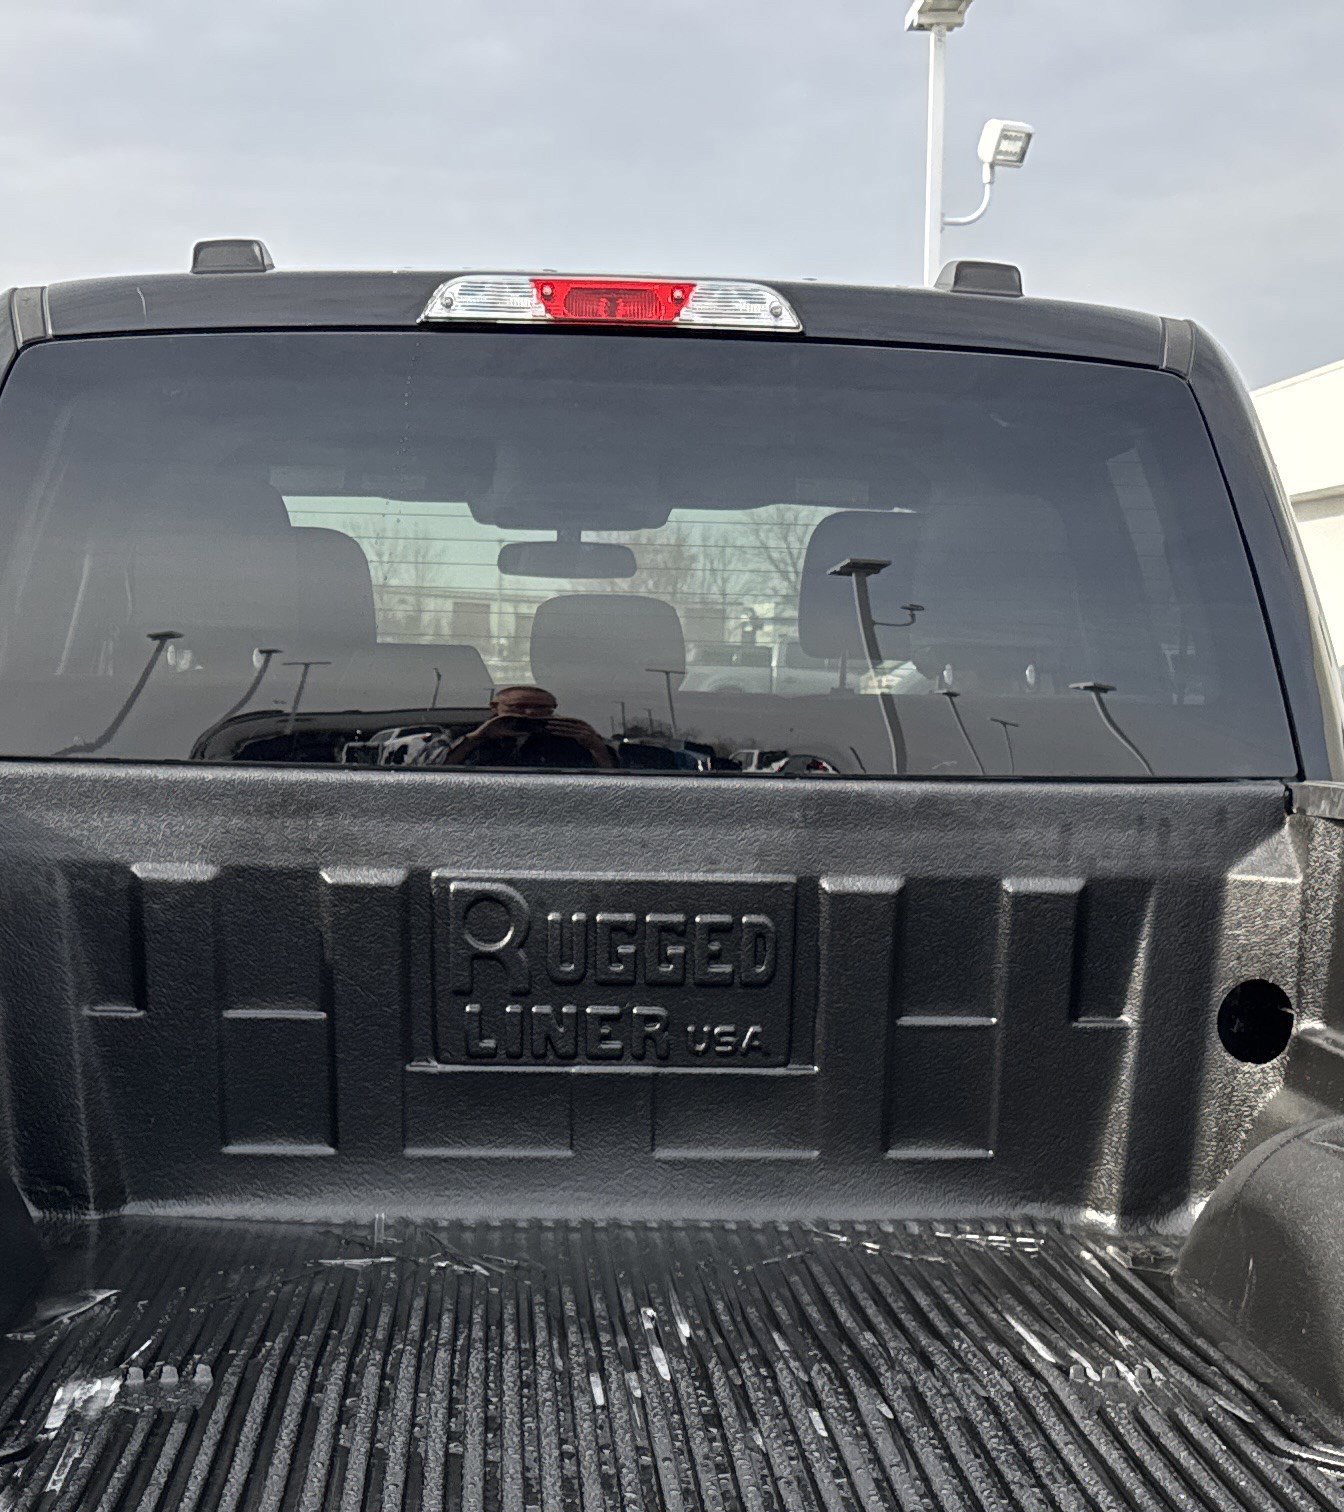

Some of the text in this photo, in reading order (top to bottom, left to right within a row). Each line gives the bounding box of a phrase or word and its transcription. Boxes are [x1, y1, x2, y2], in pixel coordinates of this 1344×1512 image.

[449, 880, 777, 998] RUGGED
[465, 1003, 770, 1059] LINER USA
